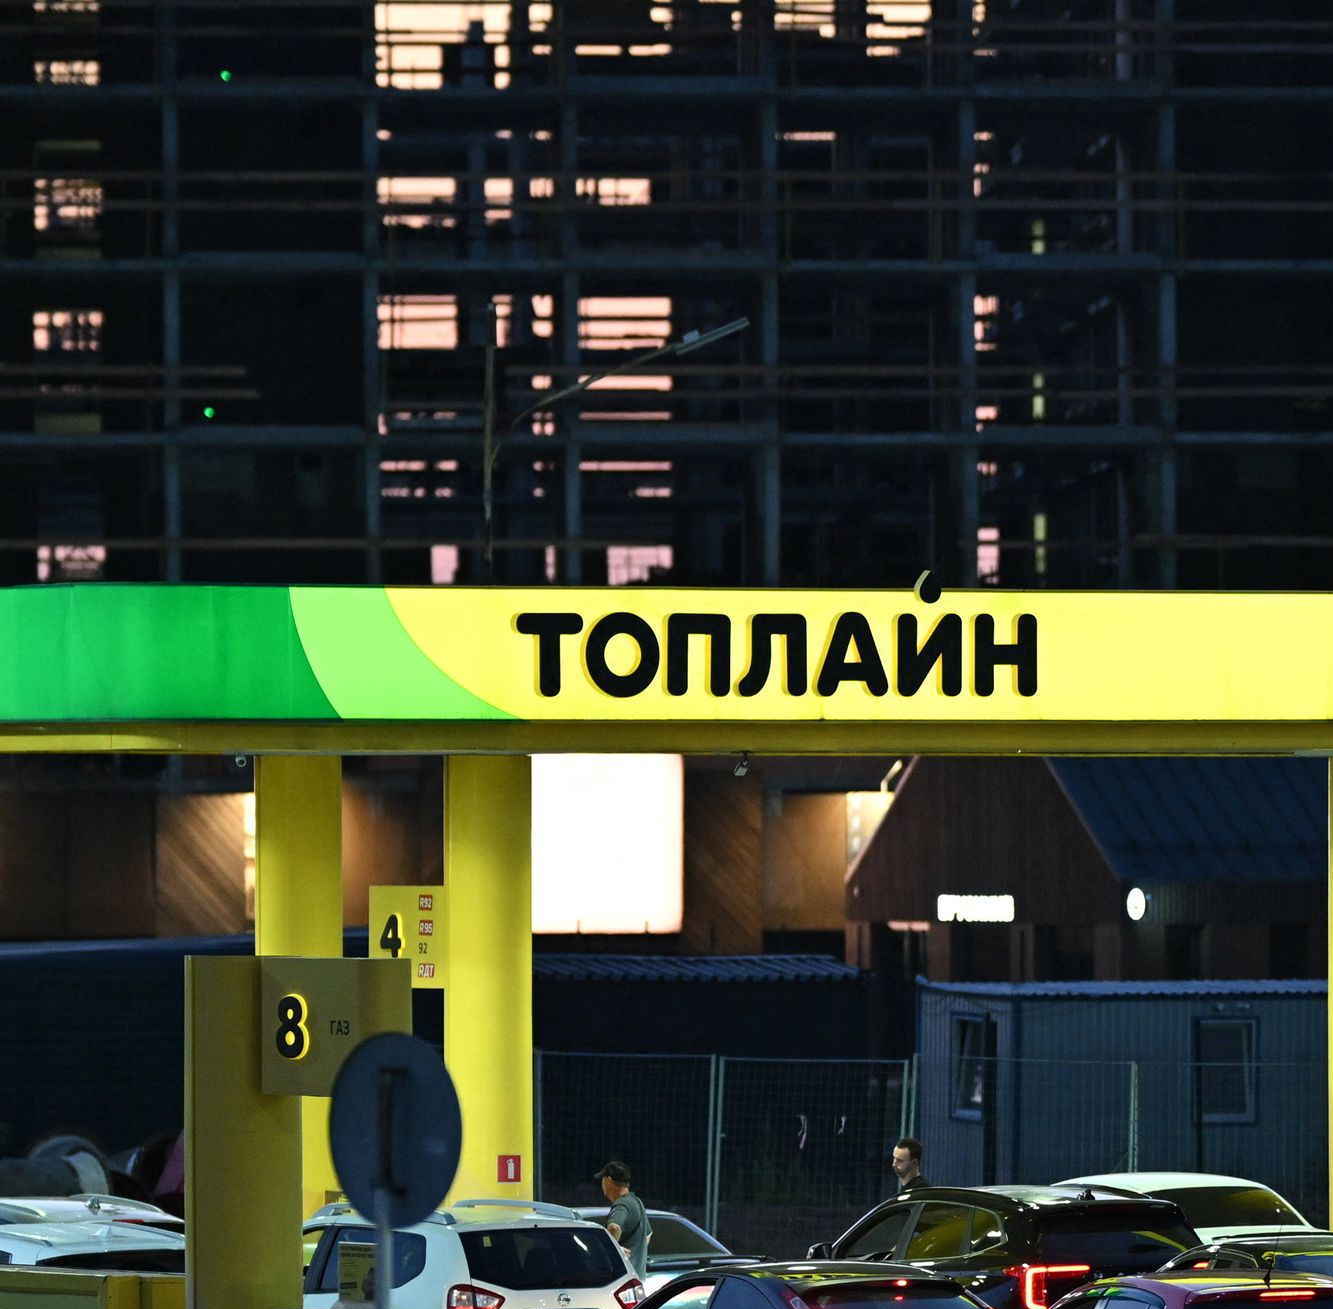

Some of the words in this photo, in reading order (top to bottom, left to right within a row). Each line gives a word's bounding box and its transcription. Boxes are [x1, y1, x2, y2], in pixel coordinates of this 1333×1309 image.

[514, 570, 1038, 698] ТОПЛАЙН
[419, 898, 432, 908] R92
[380, 914, 402, 958] 4
[419, 942, 428, 954] 92
[276, 996, 305, 1059] 8
[330, 1020, 350, 1035] ГАЗ
